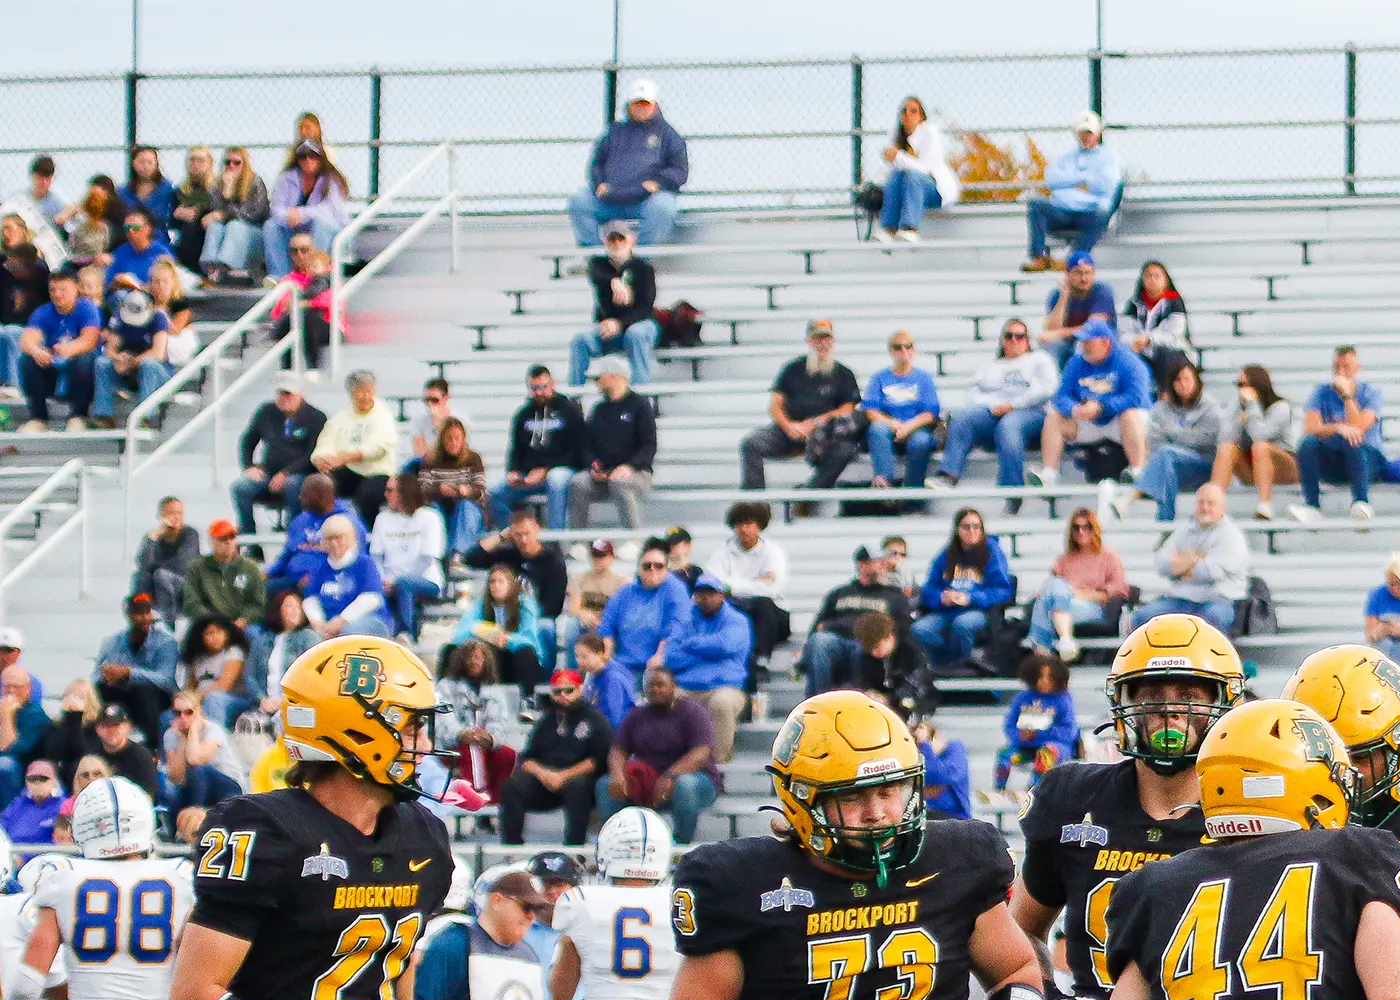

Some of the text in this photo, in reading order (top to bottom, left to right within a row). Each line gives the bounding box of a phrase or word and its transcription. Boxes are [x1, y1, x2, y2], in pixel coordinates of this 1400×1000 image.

[863, 761, 897, 775] Riddell
[1206, 818, 1264, 837] Riddell
[197, 828, 257, 881] 21
[623, 868, 660, 879] Riddell
[333, 885, 420, 910] BROCKPORT
[70, 876, 176, 967] 88
[806, 900, 919, 936] BROCKPORT
[611, 905, 654, 982] 6
